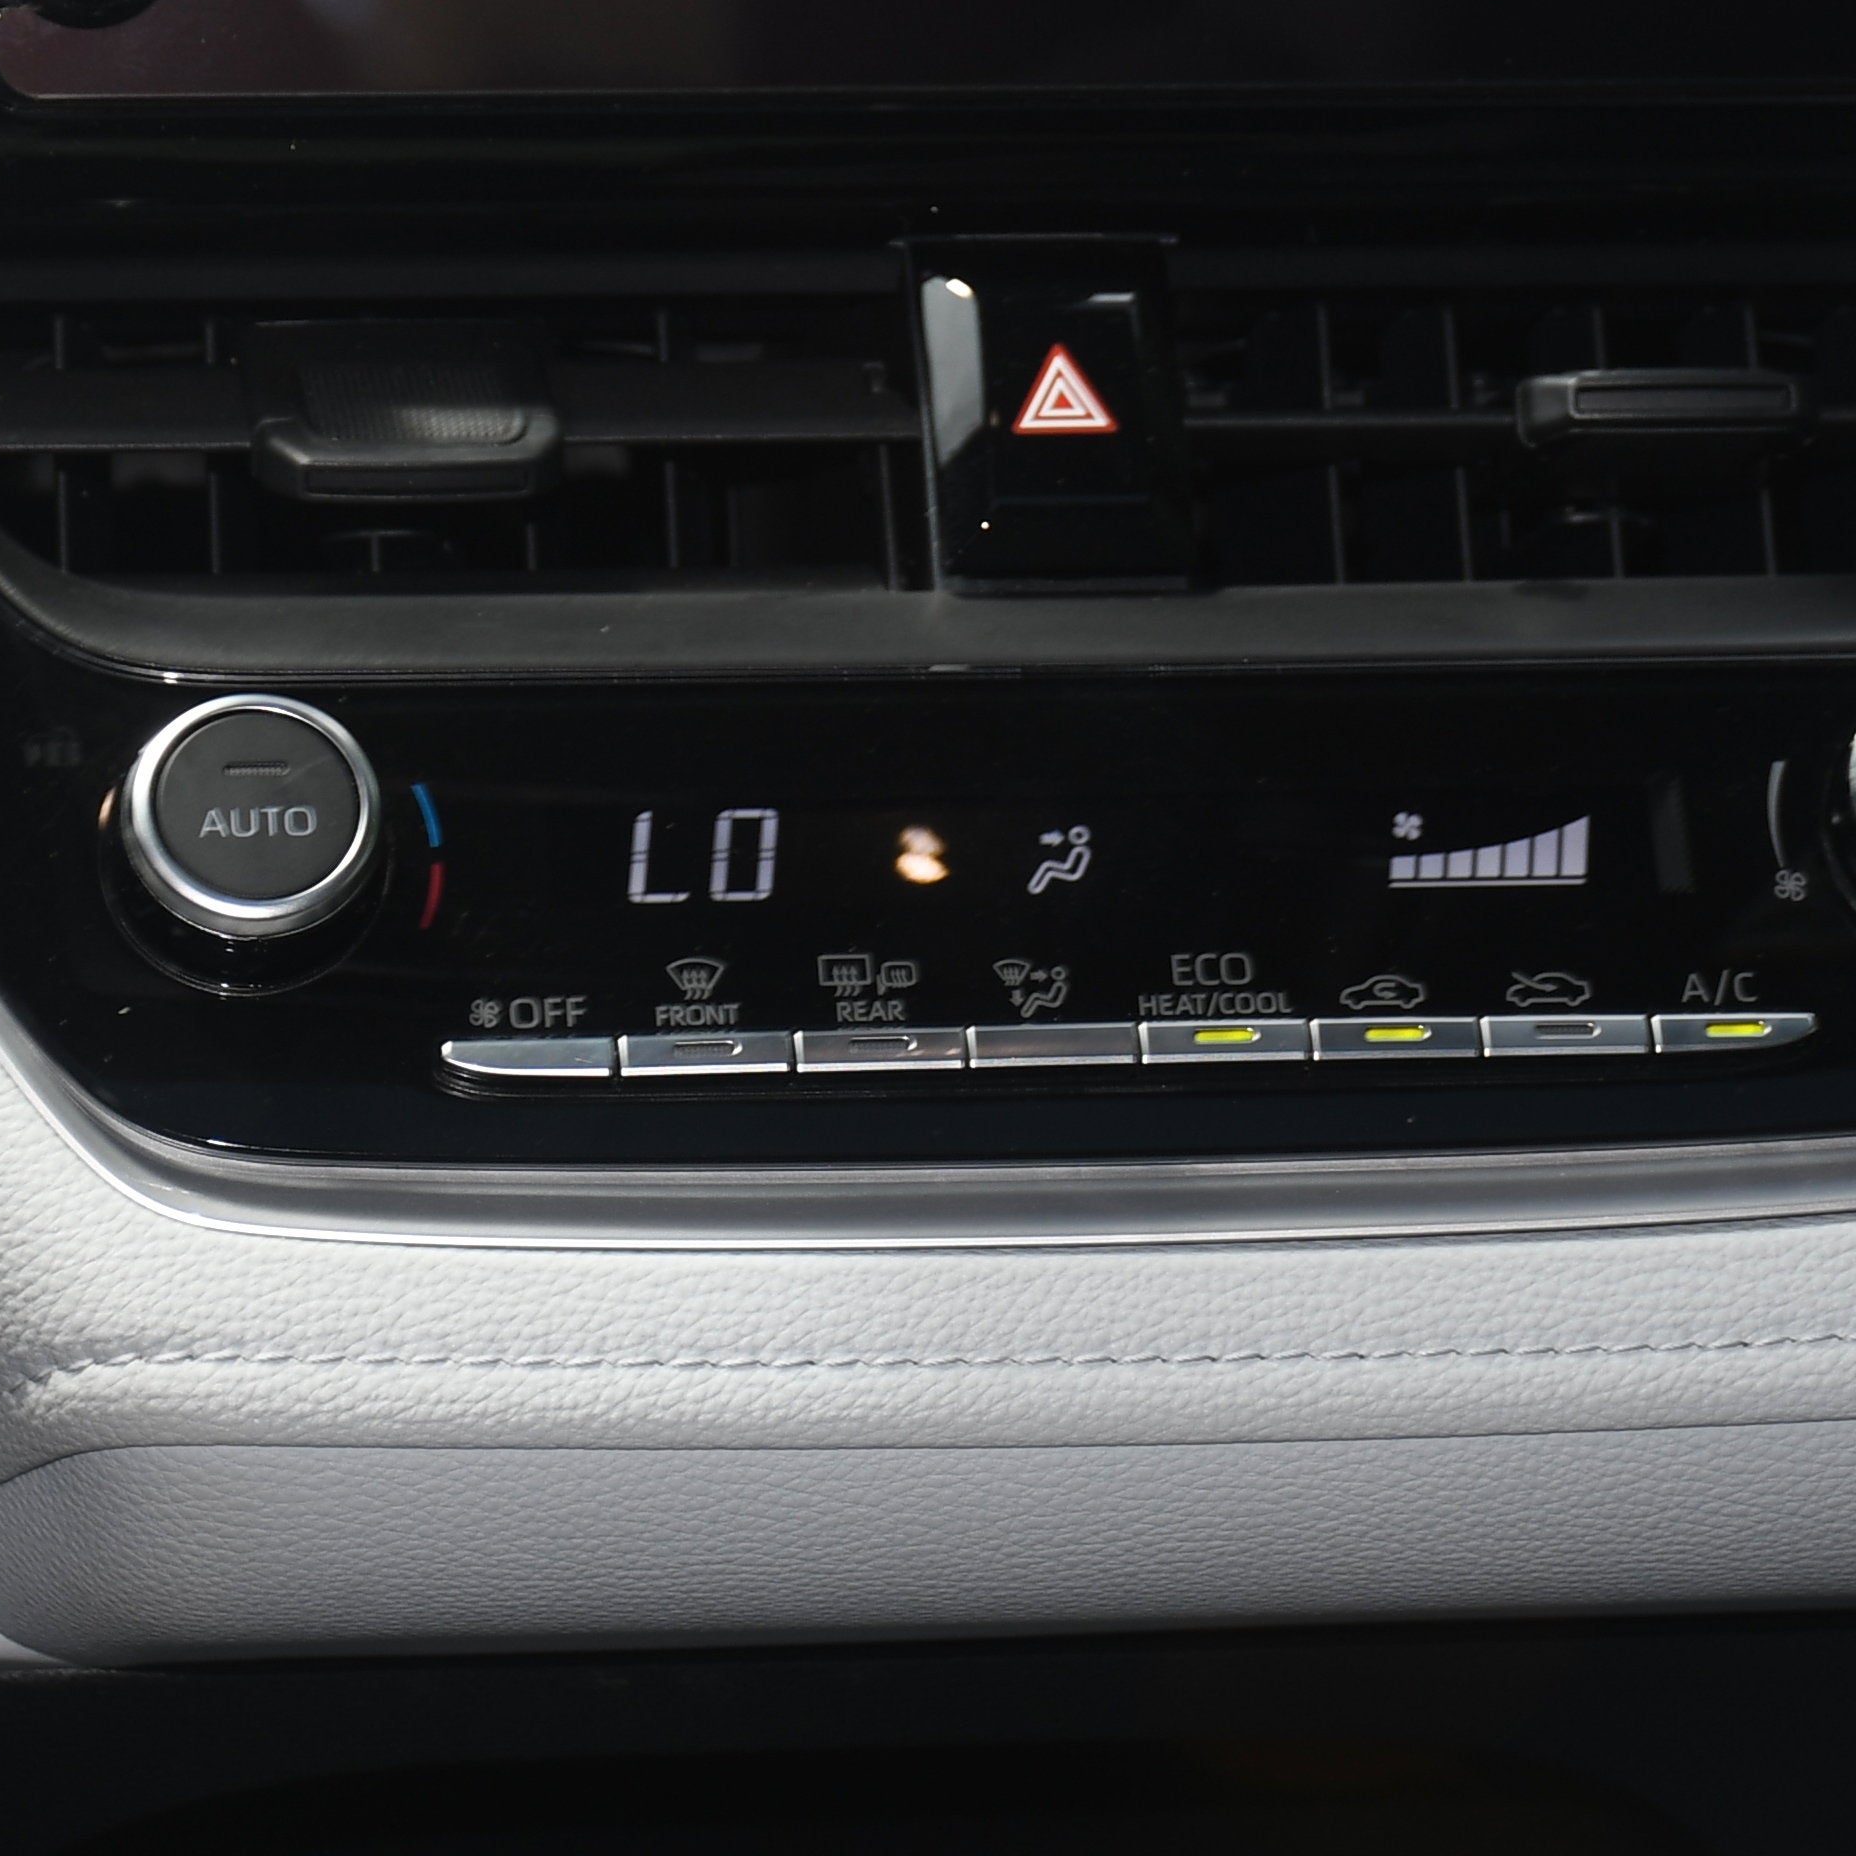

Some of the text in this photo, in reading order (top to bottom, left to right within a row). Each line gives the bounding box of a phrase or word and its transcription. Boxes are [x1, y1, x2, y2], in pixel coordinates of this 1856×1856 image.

[200, 806, 317, 838] AUTO
[627, 808, 779, 903] LO
[1170, 953, 1253, 986] ECO
[1139, 992, 1293, 1016] HEAT/COOL
[1682, 972, 1758, 1004] A/C
[509, 997, 587, 1029] OFF
[656, 1004, 739, 1027] FRONT
[836, 1002, 906, 1023] REAR
